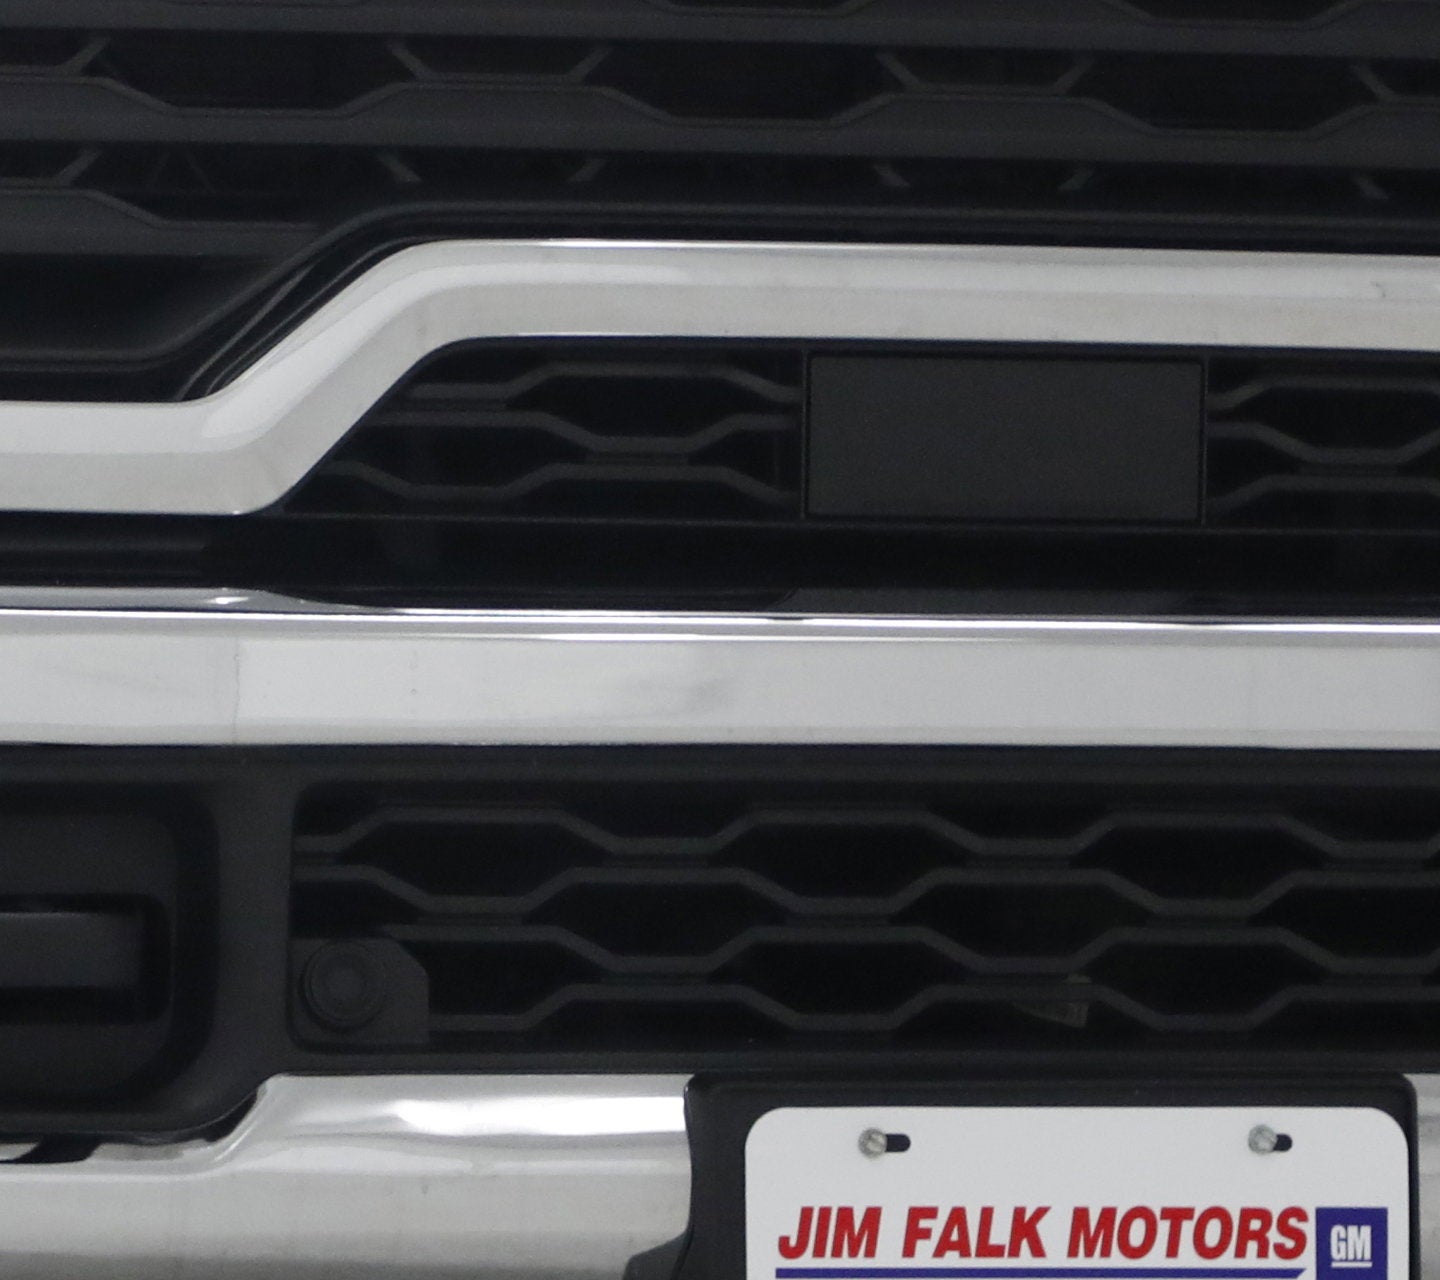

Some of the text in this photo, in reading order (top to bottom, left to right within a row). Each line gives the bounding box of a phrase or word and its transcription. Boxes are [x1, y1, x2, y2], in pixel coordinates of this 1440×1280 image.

[778, 1206, 1309, 1261] JIM FALK MOTORS
[1330, 1224, 1371, 1261] GM
